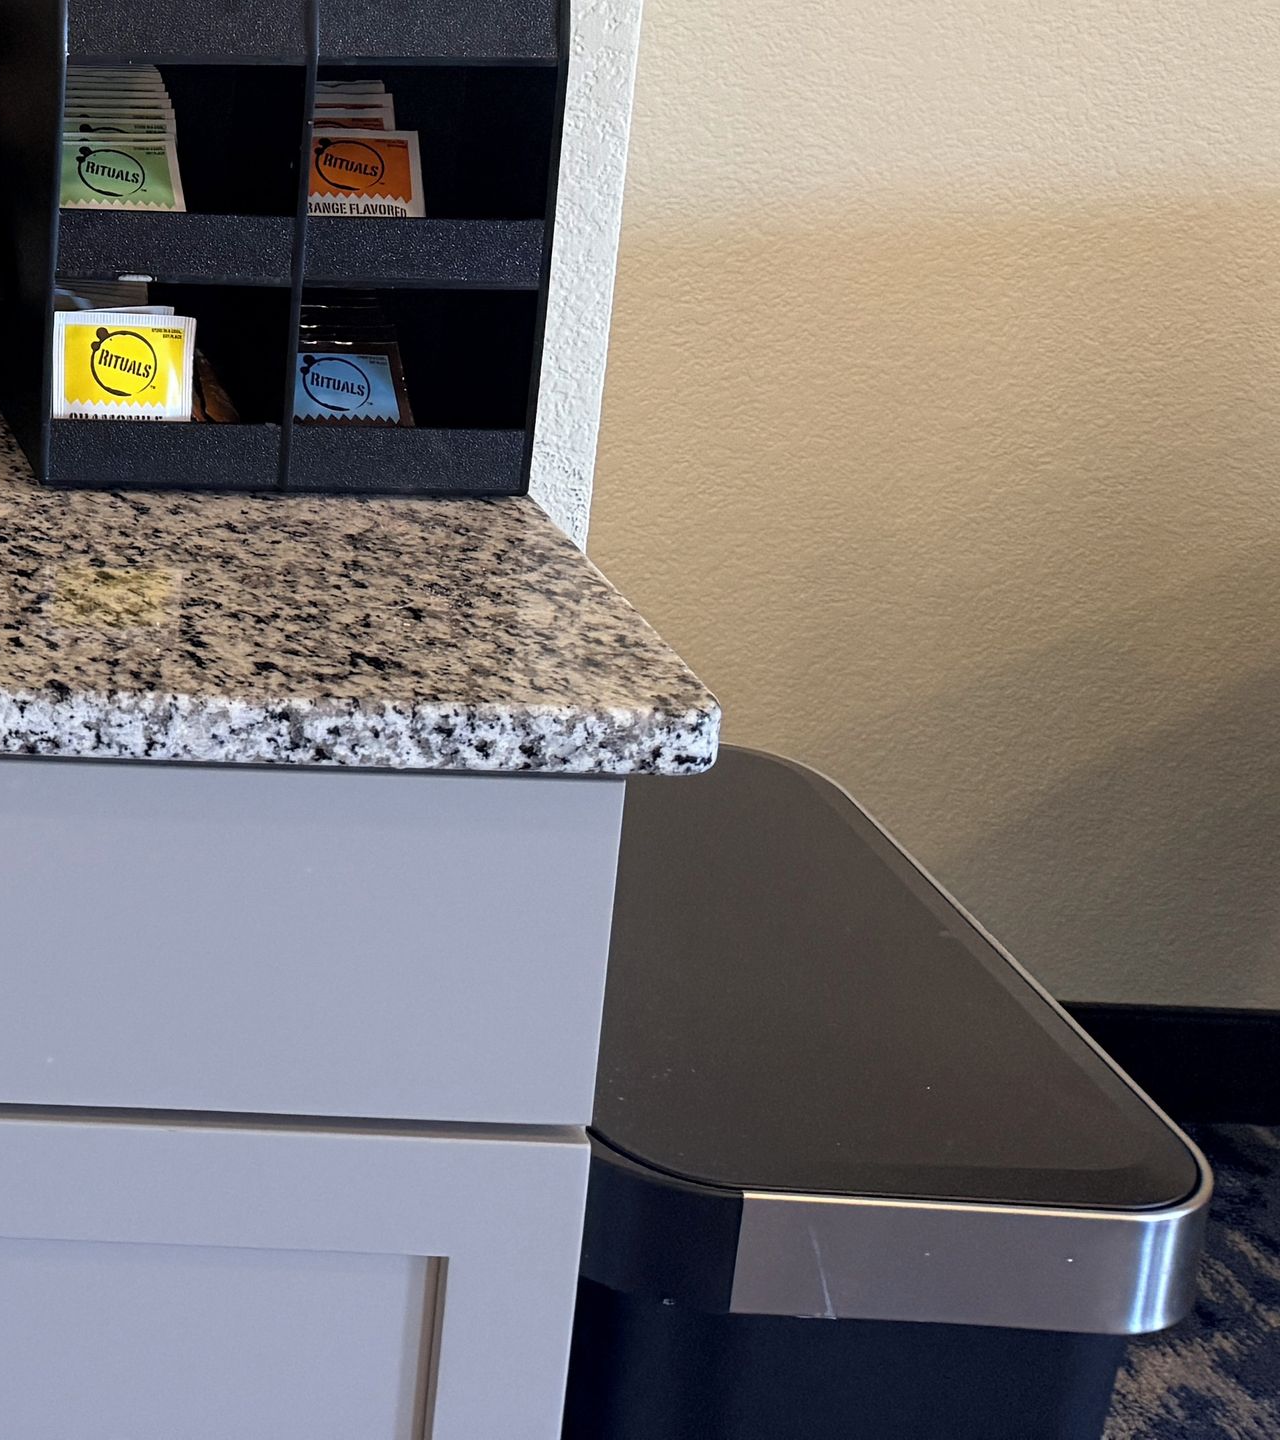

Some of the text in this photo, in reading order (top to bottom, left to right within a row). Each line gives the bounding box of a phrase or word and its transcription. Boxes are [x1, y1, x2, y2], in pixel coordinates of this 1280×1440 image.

[85, 160, 140, 184] RITUALS
[323, 153, 379, 177] RITUALS
[308, 202, 407, 218] RANGE FLAVORED
[98, 348, 152, 378] RITUALS
[310, 371, 366, 397] RITUALS
